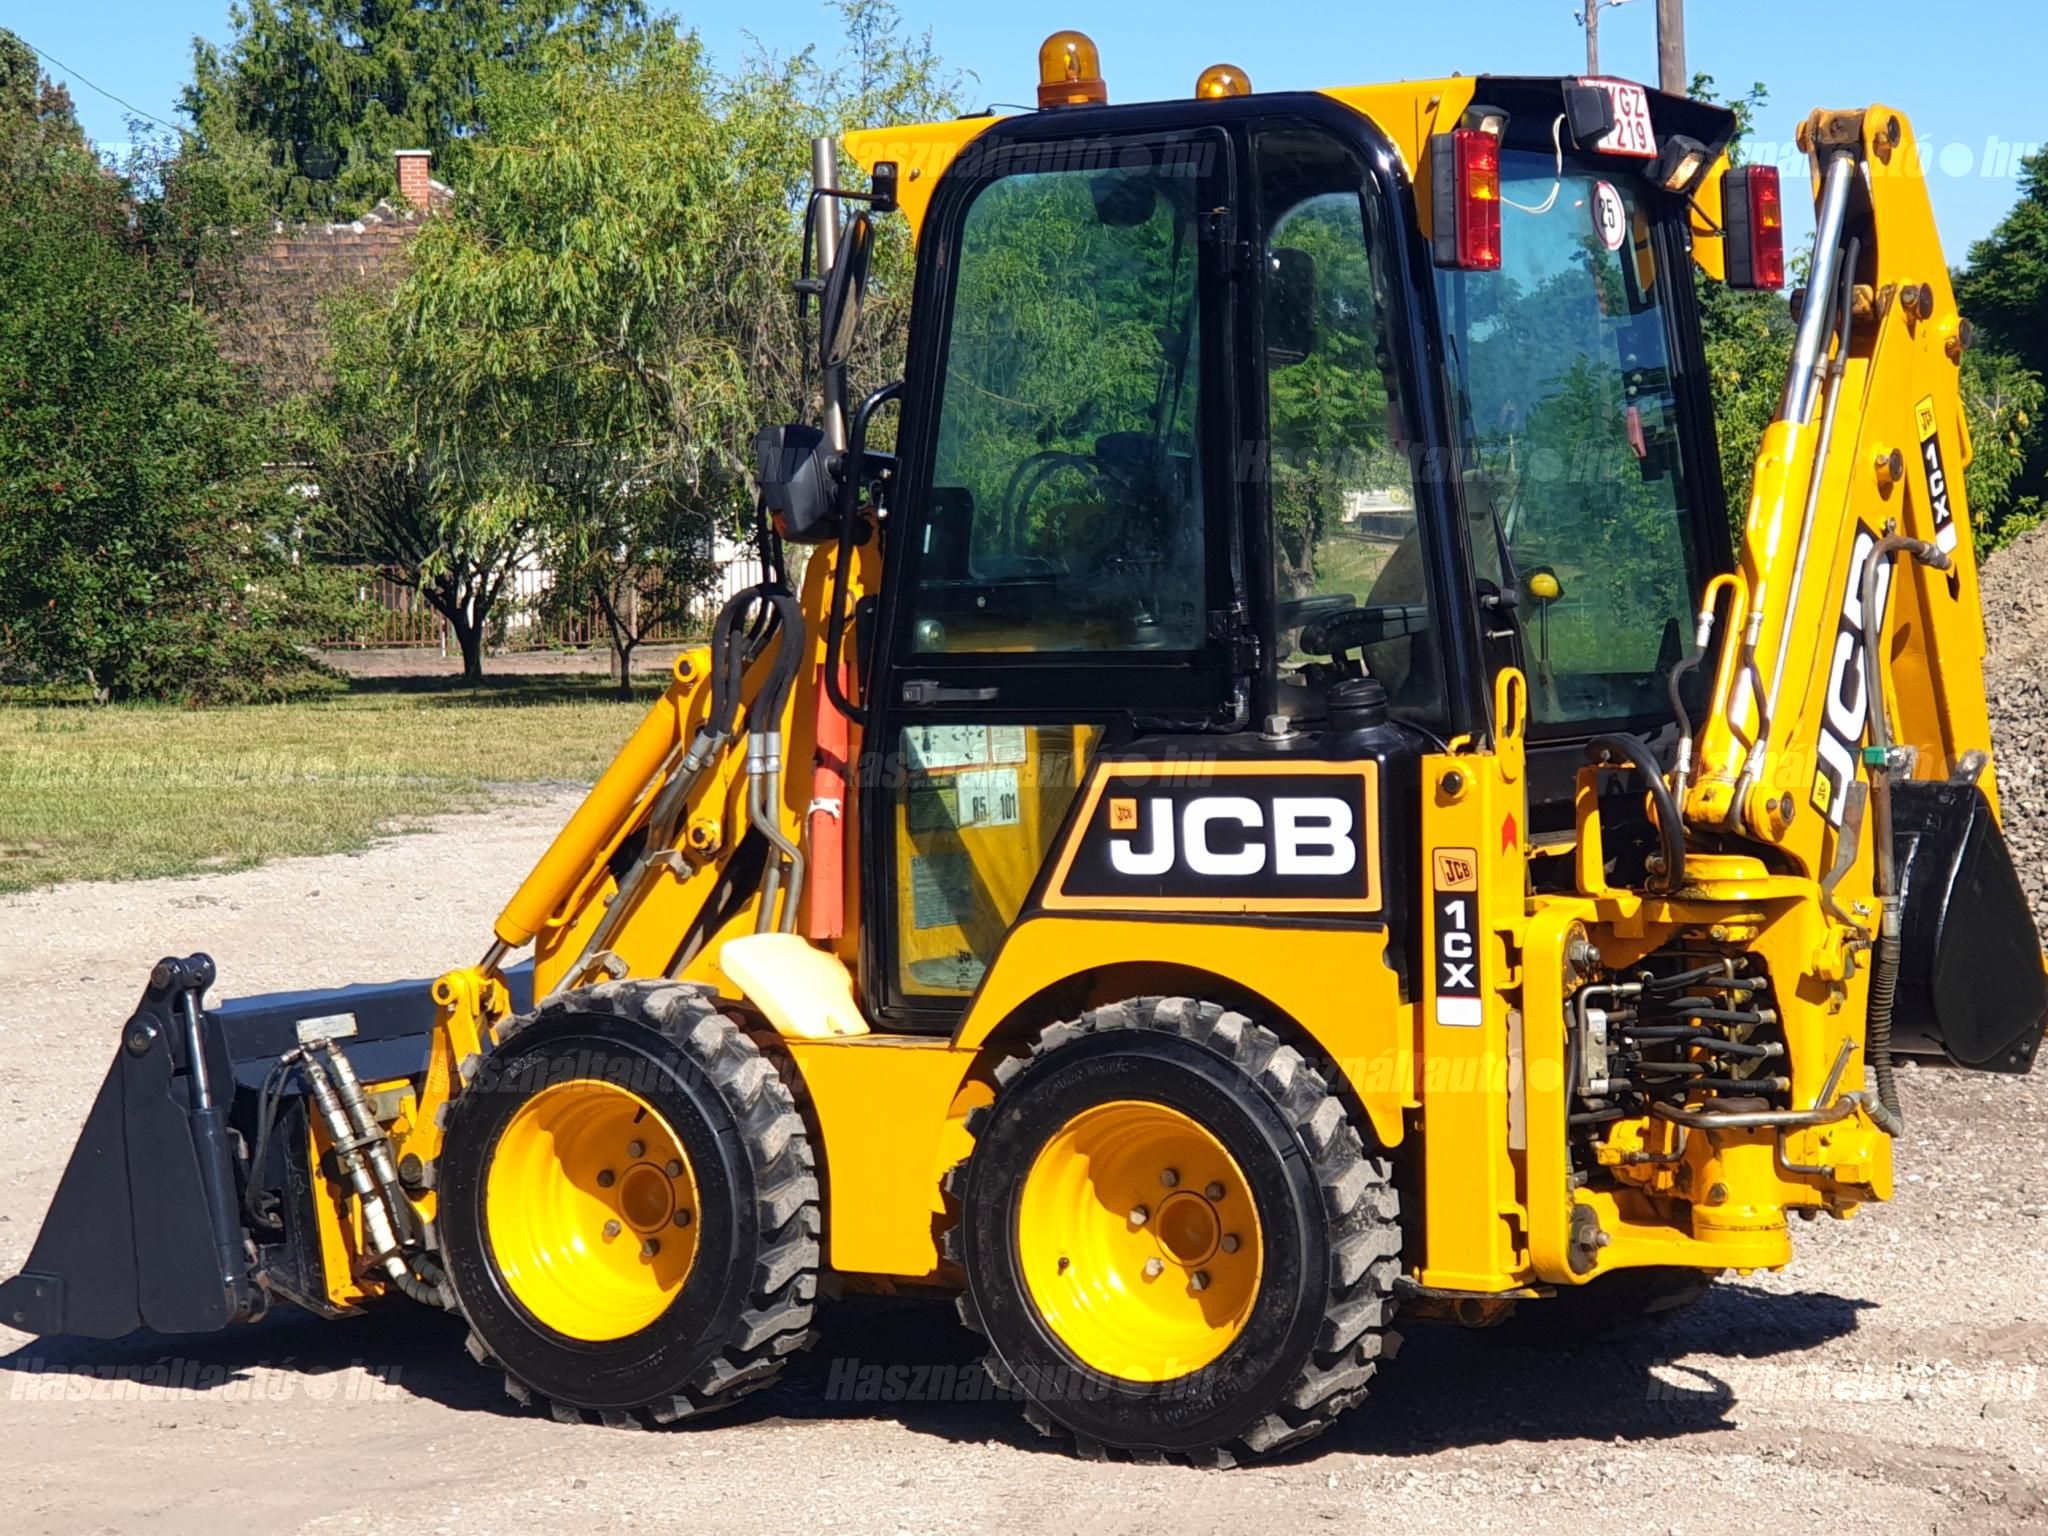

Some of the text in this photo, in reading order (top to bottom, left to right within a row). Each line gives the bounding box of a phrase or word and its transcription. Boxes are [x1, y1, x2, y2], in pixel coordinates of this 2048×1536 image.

[1598, 197, 1616, 229] 25
[1926, 442, 1950, 525] 1CX
[999, 792, 1017, 821] 101
[1110, 796, 1356, 876] JCB
[1445, 859, 1471, 883] JCB
[1443, 900, 1475, 988] 1CX
